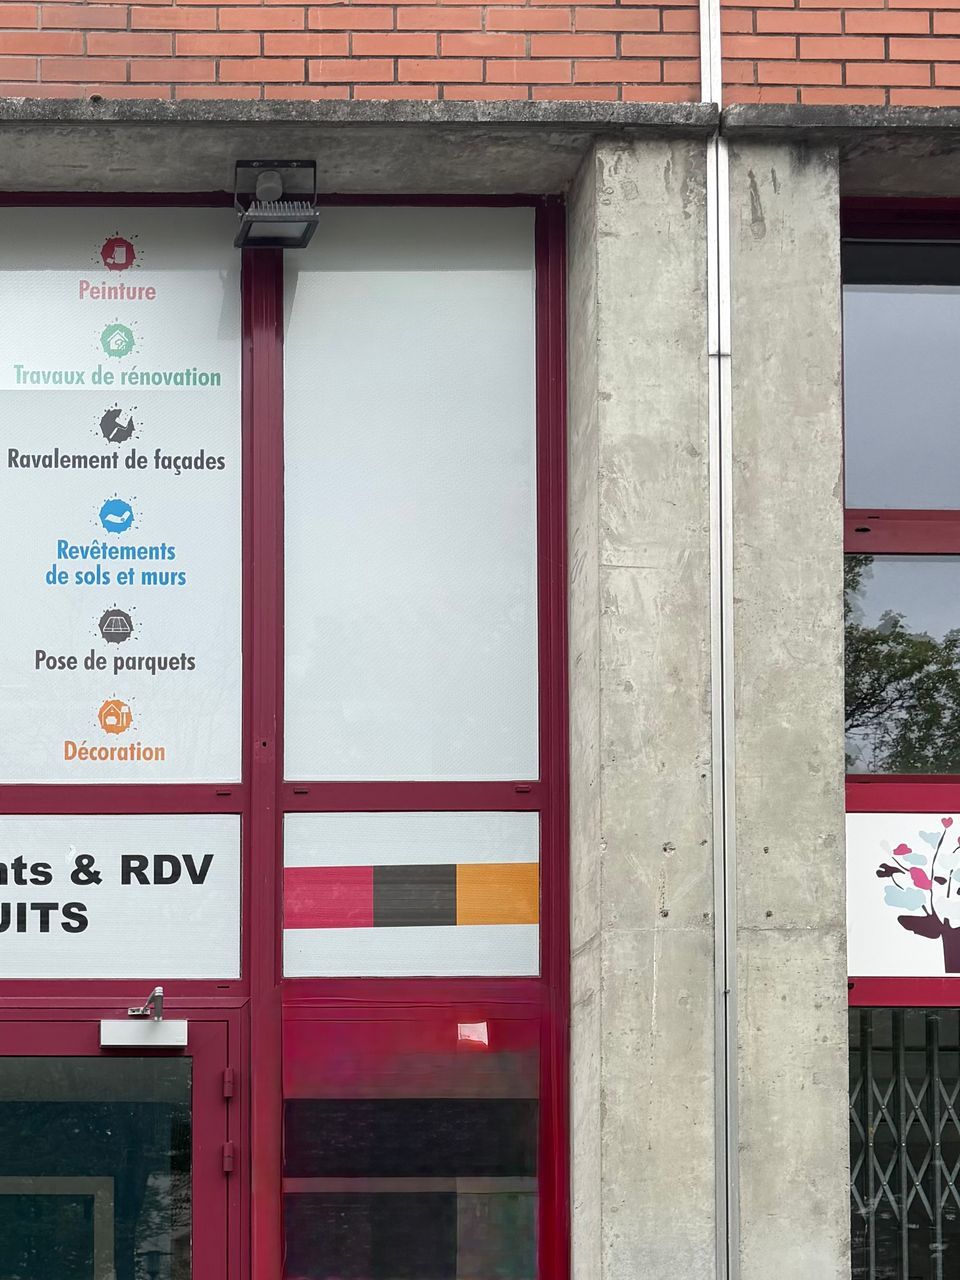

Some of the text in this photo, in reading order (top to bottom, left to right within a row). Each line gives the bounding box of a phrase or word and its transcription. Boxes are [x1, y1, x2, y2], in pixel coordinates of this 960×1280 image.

[77, 280, 158, 303] Peinture
[14, 364, 220, 386] Travaux de rénovation
[8, 447, 225, 475] Ravalement de façades
[58, 537, 175, 560] Revêtements
[46, 564, 186, 585] de sols et murs
[36, 649, 195, 675] Pose de parquets
[65, 740, 164, 760] Décoration
[71, 854, 102, 885] &
[121, 854, 214, 885] RDV
